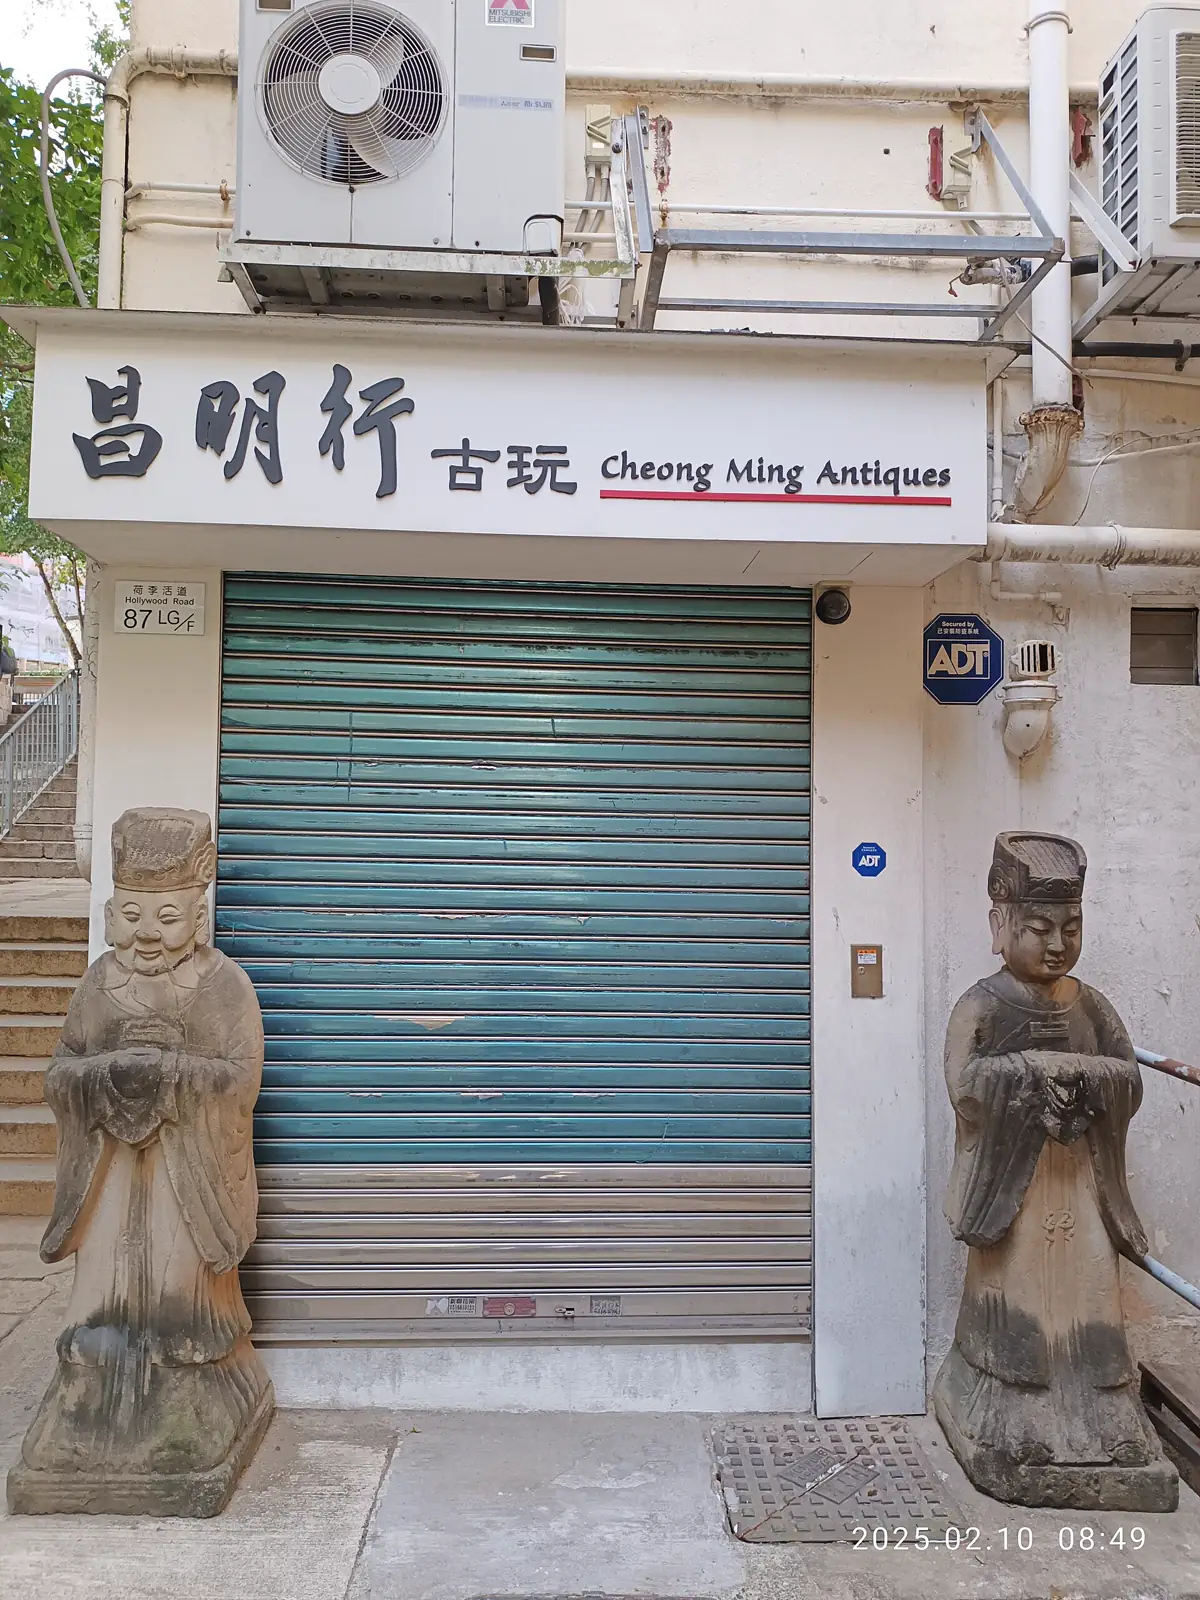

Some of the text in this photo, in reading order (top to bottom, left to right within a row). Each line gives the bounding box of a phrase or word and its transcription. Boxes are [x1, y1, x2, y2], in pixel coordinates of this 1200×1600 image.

[489, 9, 531, 17] MITSUBISHI
[489, 16, 525, 24] ELECTRIC
[72, 363, 578, 499] 昌明行 古玩
[601, 450, 951, 497] Cheong Ming Antiques
[133, 584, 187, 597] 荷李活道
[125, 596, 195, 606] Hollywood Road
[123, 608, 195, 632] 87 LG/F
[966, 621, 975, 629] by
[928, 643, 988, 675] ADT
[858, 854, 881, 867] ADT
